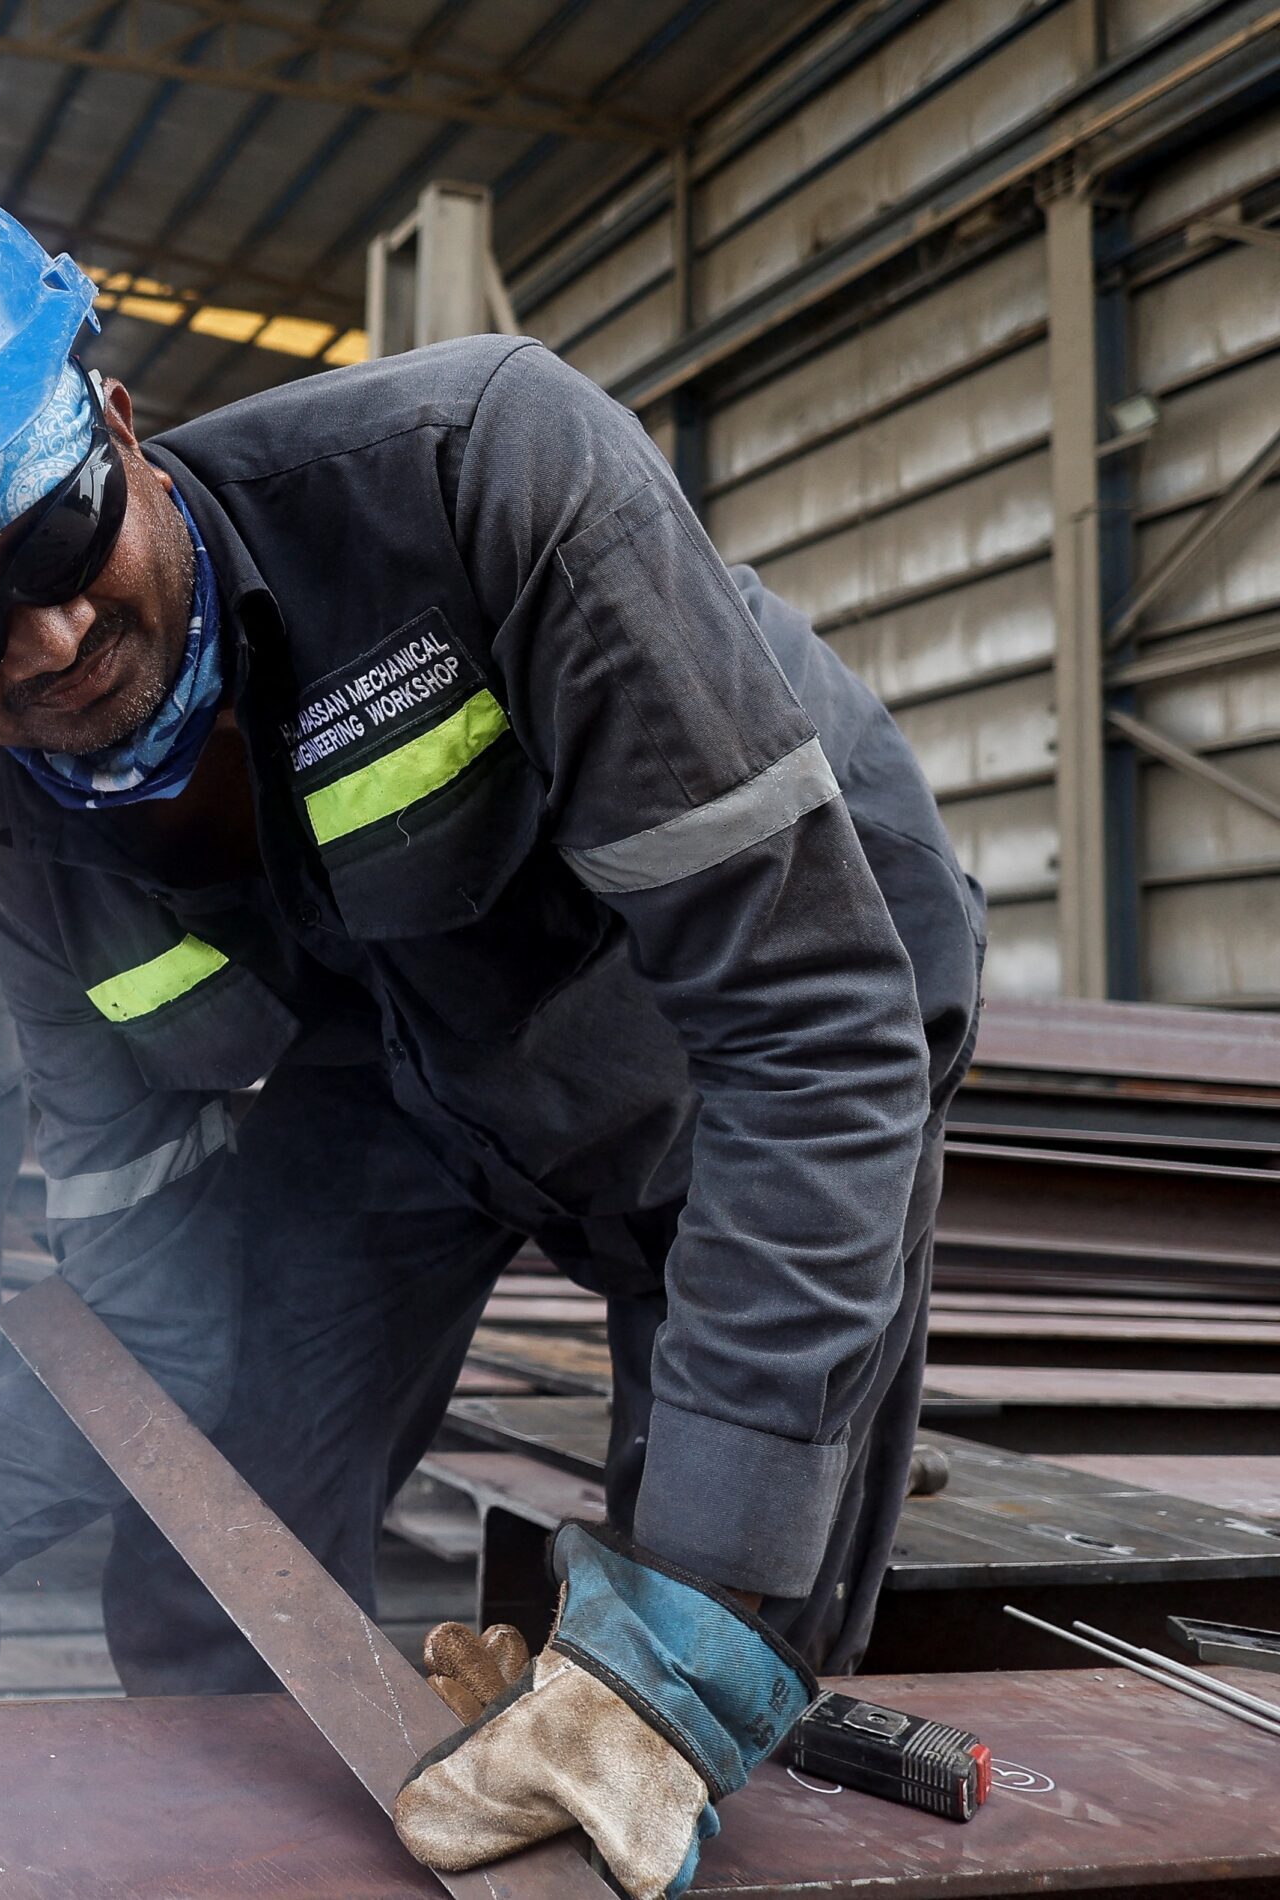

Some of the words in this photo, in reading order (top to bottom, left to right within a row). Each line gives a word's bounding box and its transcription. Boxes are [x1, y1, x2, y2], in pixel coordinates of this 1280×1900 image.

[290, 715, 365, 772] ENGINEERING
[364, 656, 459, 727] WORKSHOP
[299, 689, 350, 735] HASSAN
[344, 632, 450, 706] MECHANICAL
